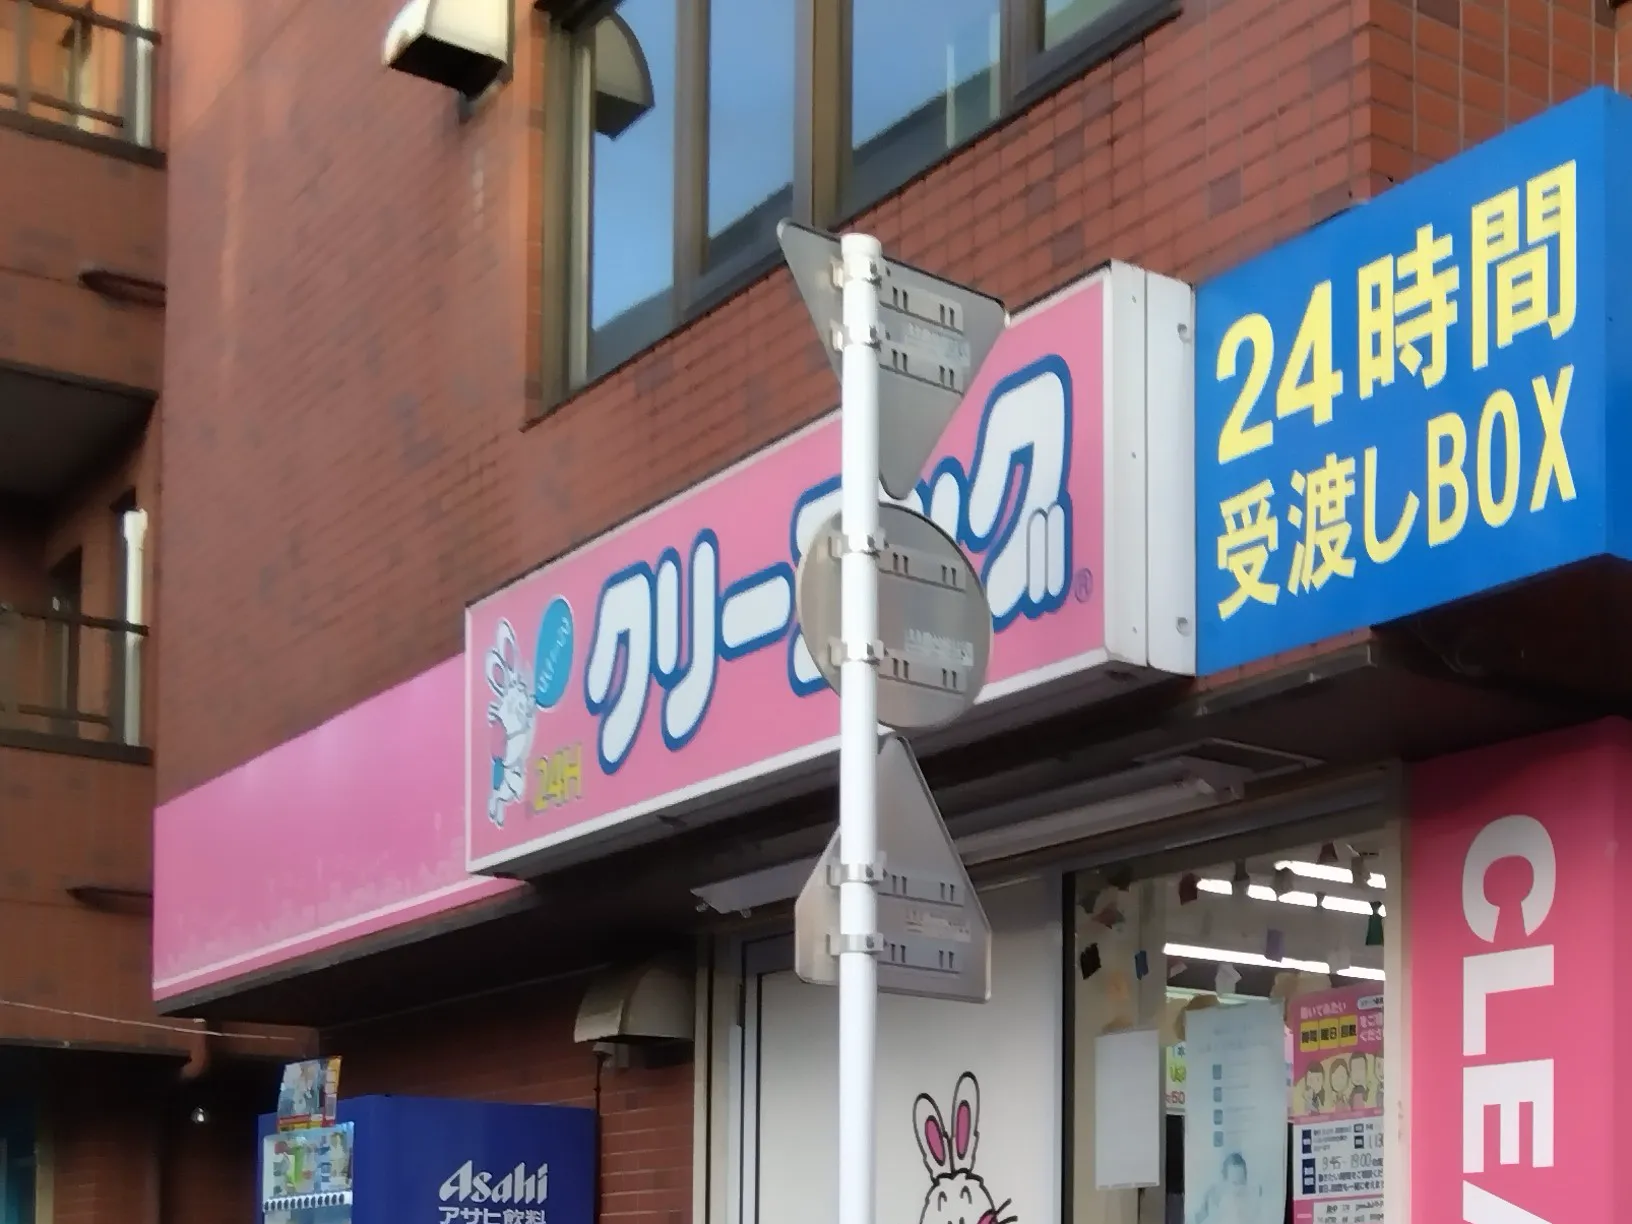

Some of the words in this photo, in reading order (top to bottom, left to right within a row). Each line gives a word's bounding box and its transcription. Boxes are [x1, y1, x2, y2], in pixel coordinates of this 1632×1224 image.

[1216, 159, 1578, 465] 24時間
[585, 353, 1073, 774] クリーグ
[1216, 364, 1578, 622] 受渡しBOX
[533, 741, 583, 815] 24H
[438, 1159, 548, 1205] Asahi
